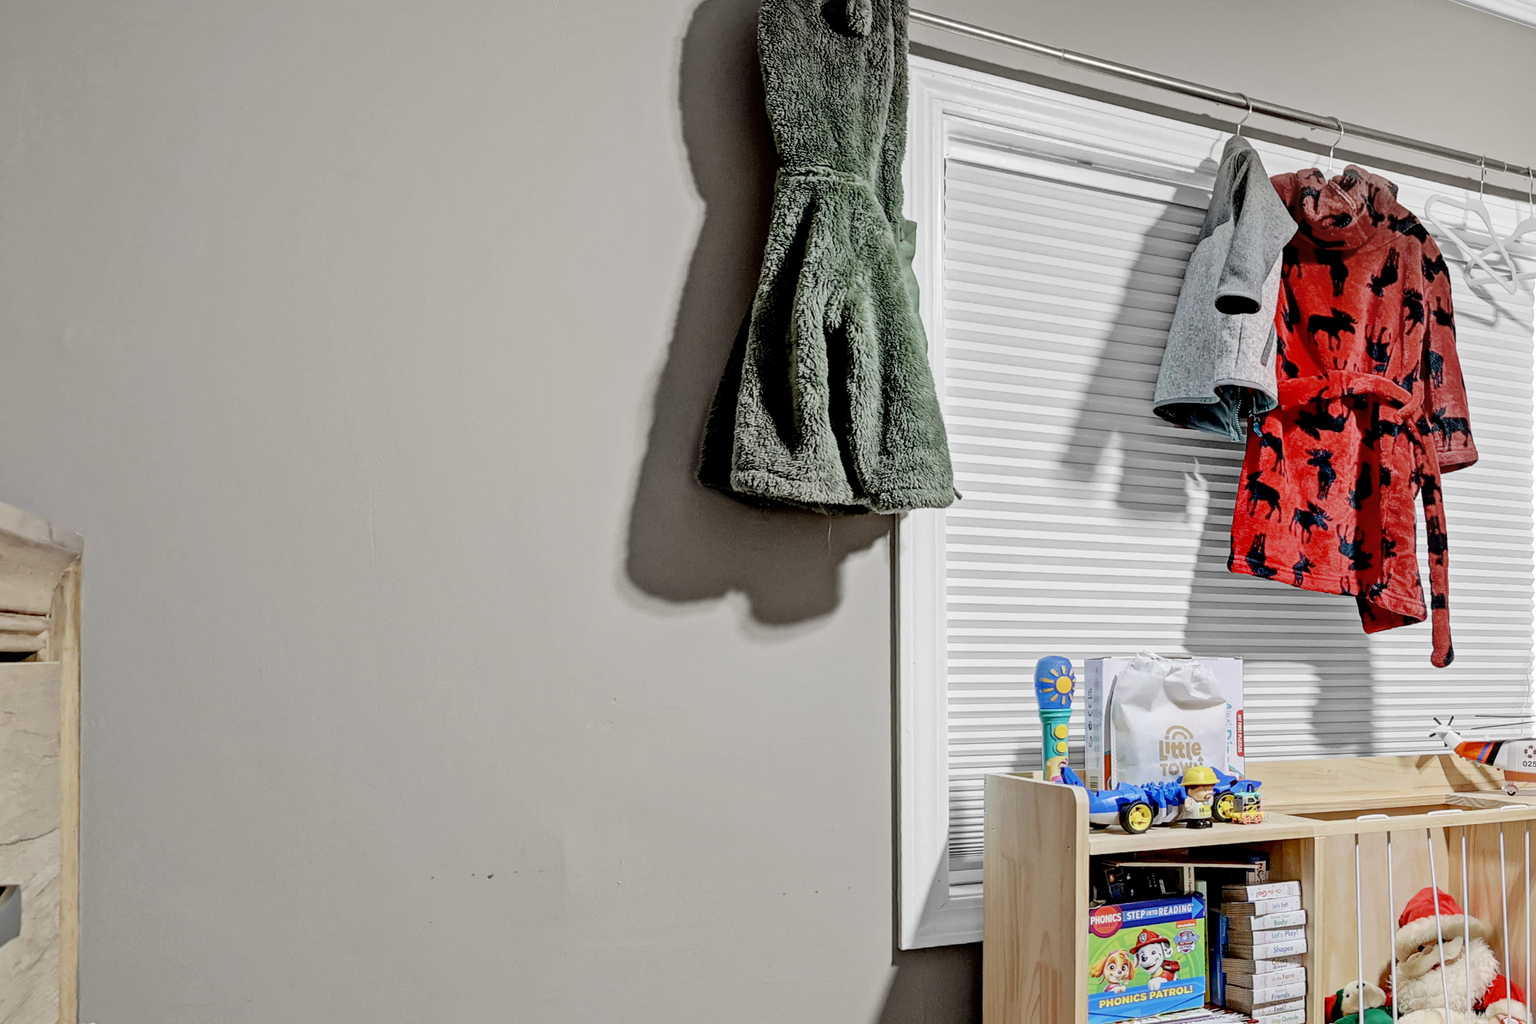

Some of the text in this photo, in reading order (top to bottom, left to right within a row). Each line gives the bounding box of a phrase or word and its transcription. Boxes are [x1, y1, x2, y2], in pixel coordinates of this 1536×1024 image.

[1159, 739, 1202, 761] Little
[1126, 910, 1145, 920] STEP
[1158, 904, 1193, 917] READING
[1090, 913, 1122, 926] PHONICS
[1273, 946, 1293, 954] Shapes
[1099, 985, 1194, 1009] PHONICS PATROL!
[1272, 991, 1290, 1000] Friends
